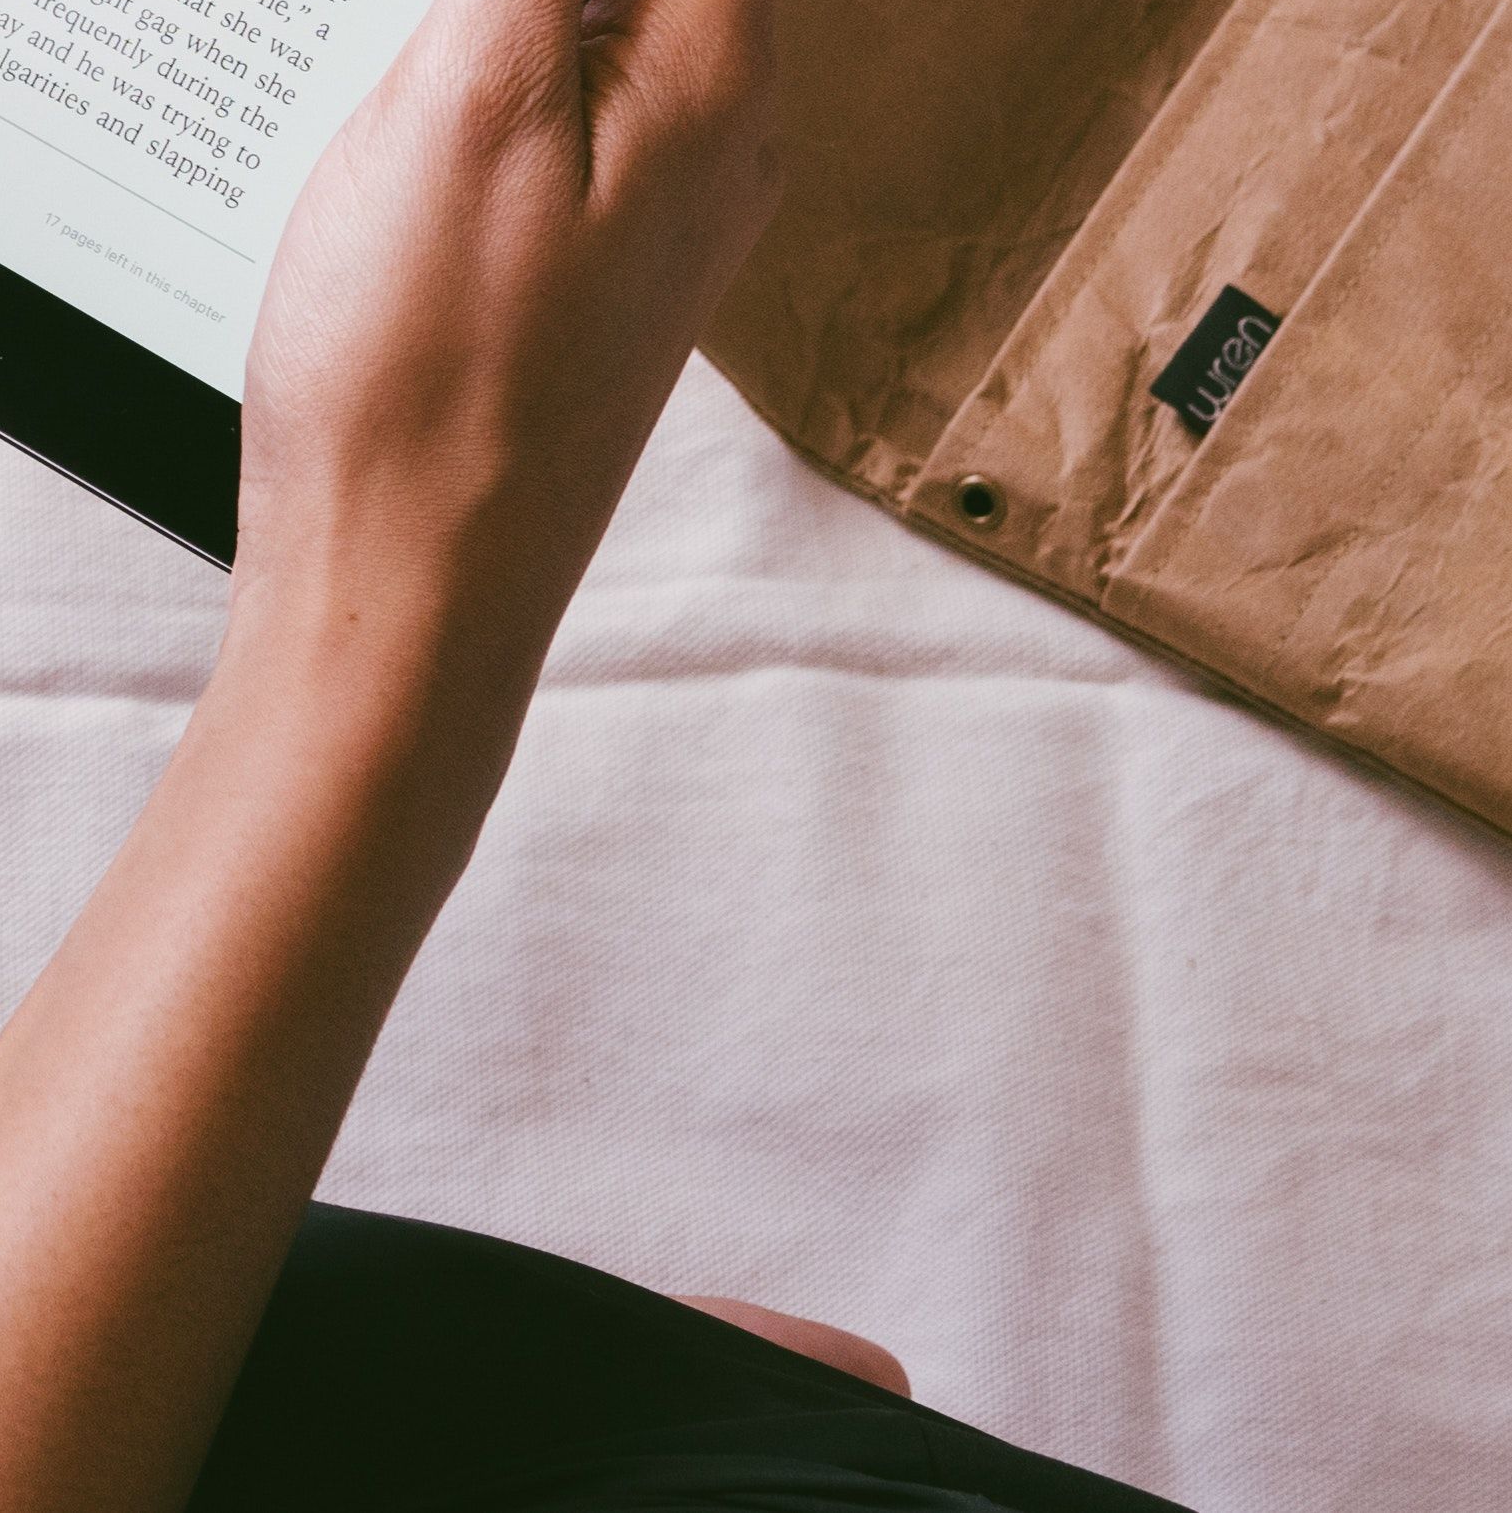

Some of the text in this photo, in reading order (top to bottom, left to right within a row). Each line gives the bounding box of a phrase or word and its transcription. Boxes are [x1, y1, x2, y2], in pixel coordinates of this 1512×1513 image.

[156, 57, 236, 119] during
[239, 104, 279, 139] the
[95, 111, 145, 146] and
[144, 138, 246, 210] slapping
[44, 212, 227, 324] 17 pages left in this chapter
